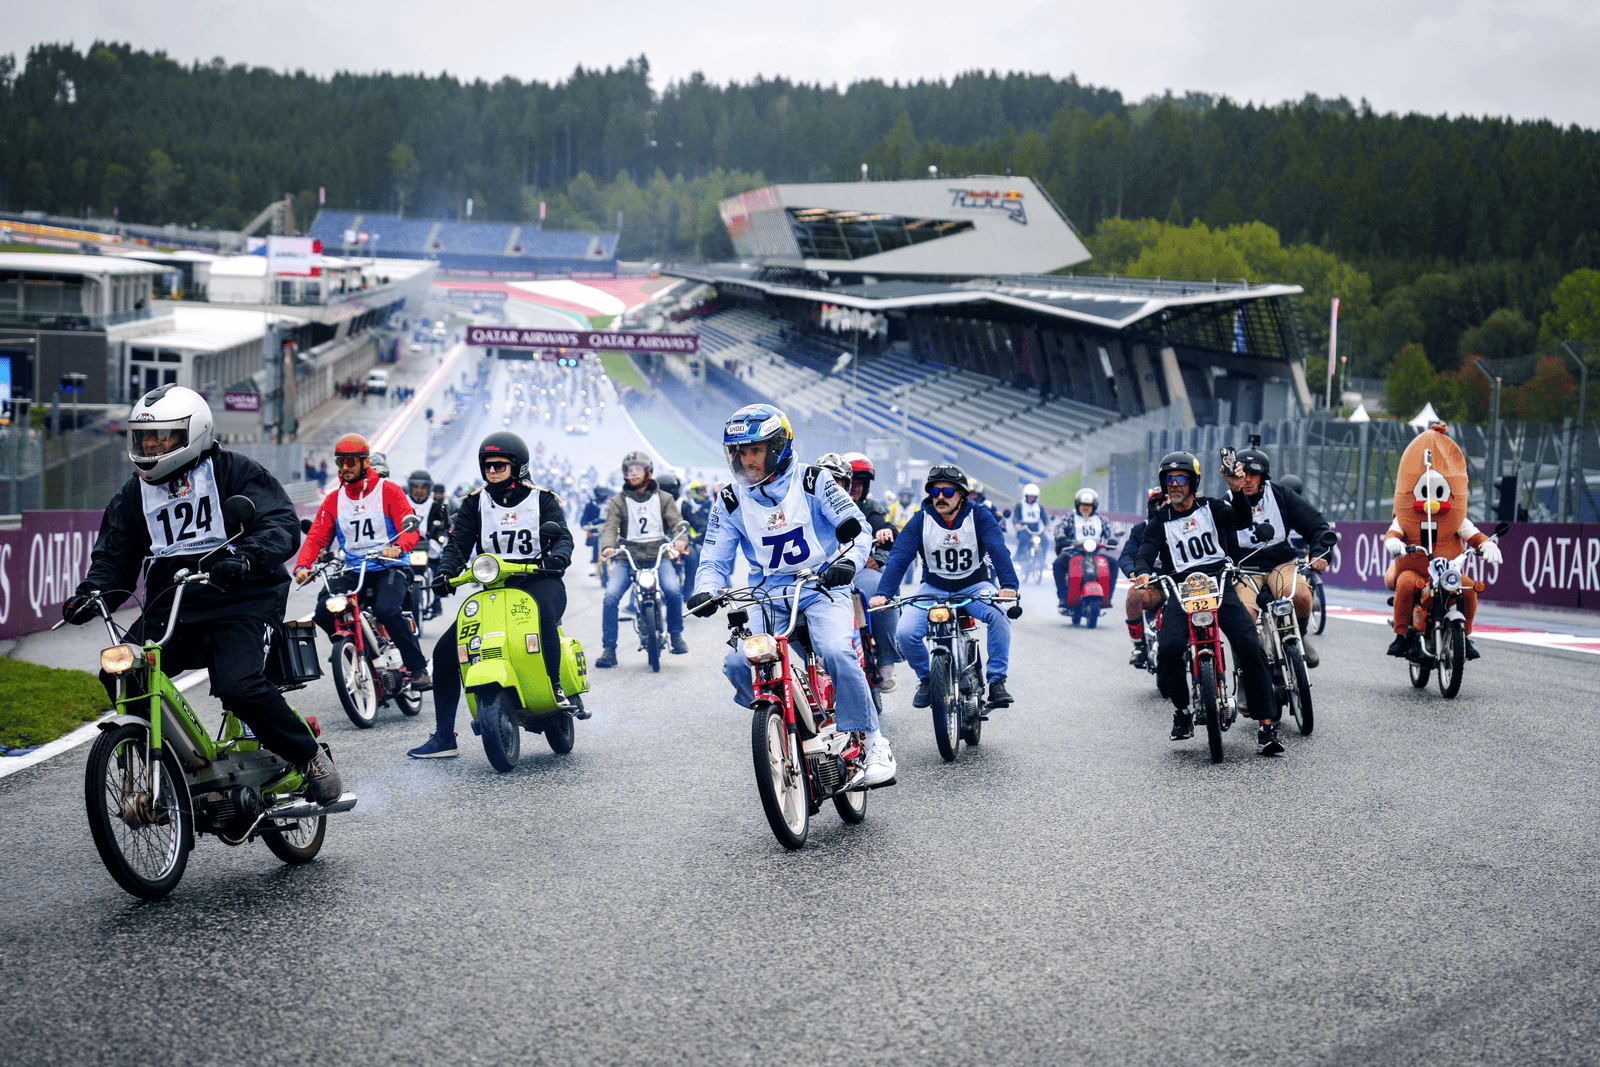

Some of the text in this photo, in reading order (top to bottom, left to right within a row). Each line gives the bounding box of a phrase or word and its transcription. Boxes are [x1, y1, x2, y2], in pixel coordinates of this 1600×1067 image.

[472, 329, 579, 346] QATAR AIRWAYS
[589, 333, 695, 350] QATAR AIRWAYS
[729, 424, 745, 433] SHOEI
[156, 495, 213, 546] 124
[350, 518, 375, 542] 74
[639, 517, 649, 534] 2
[489, 529, 533, 555] 173
[762, 526, 811, 568] 73
[1176, 532, 1217, 563] 100
[932, 548, 973, 572] 193
[1520, 536, 1600, 594] QATAR
[28, 532, 83, 618] QATAR
[1193, 601, 1208, 610] 32
[459, 623, 481, 640] 93
[575, 651, 587, 676] 93
